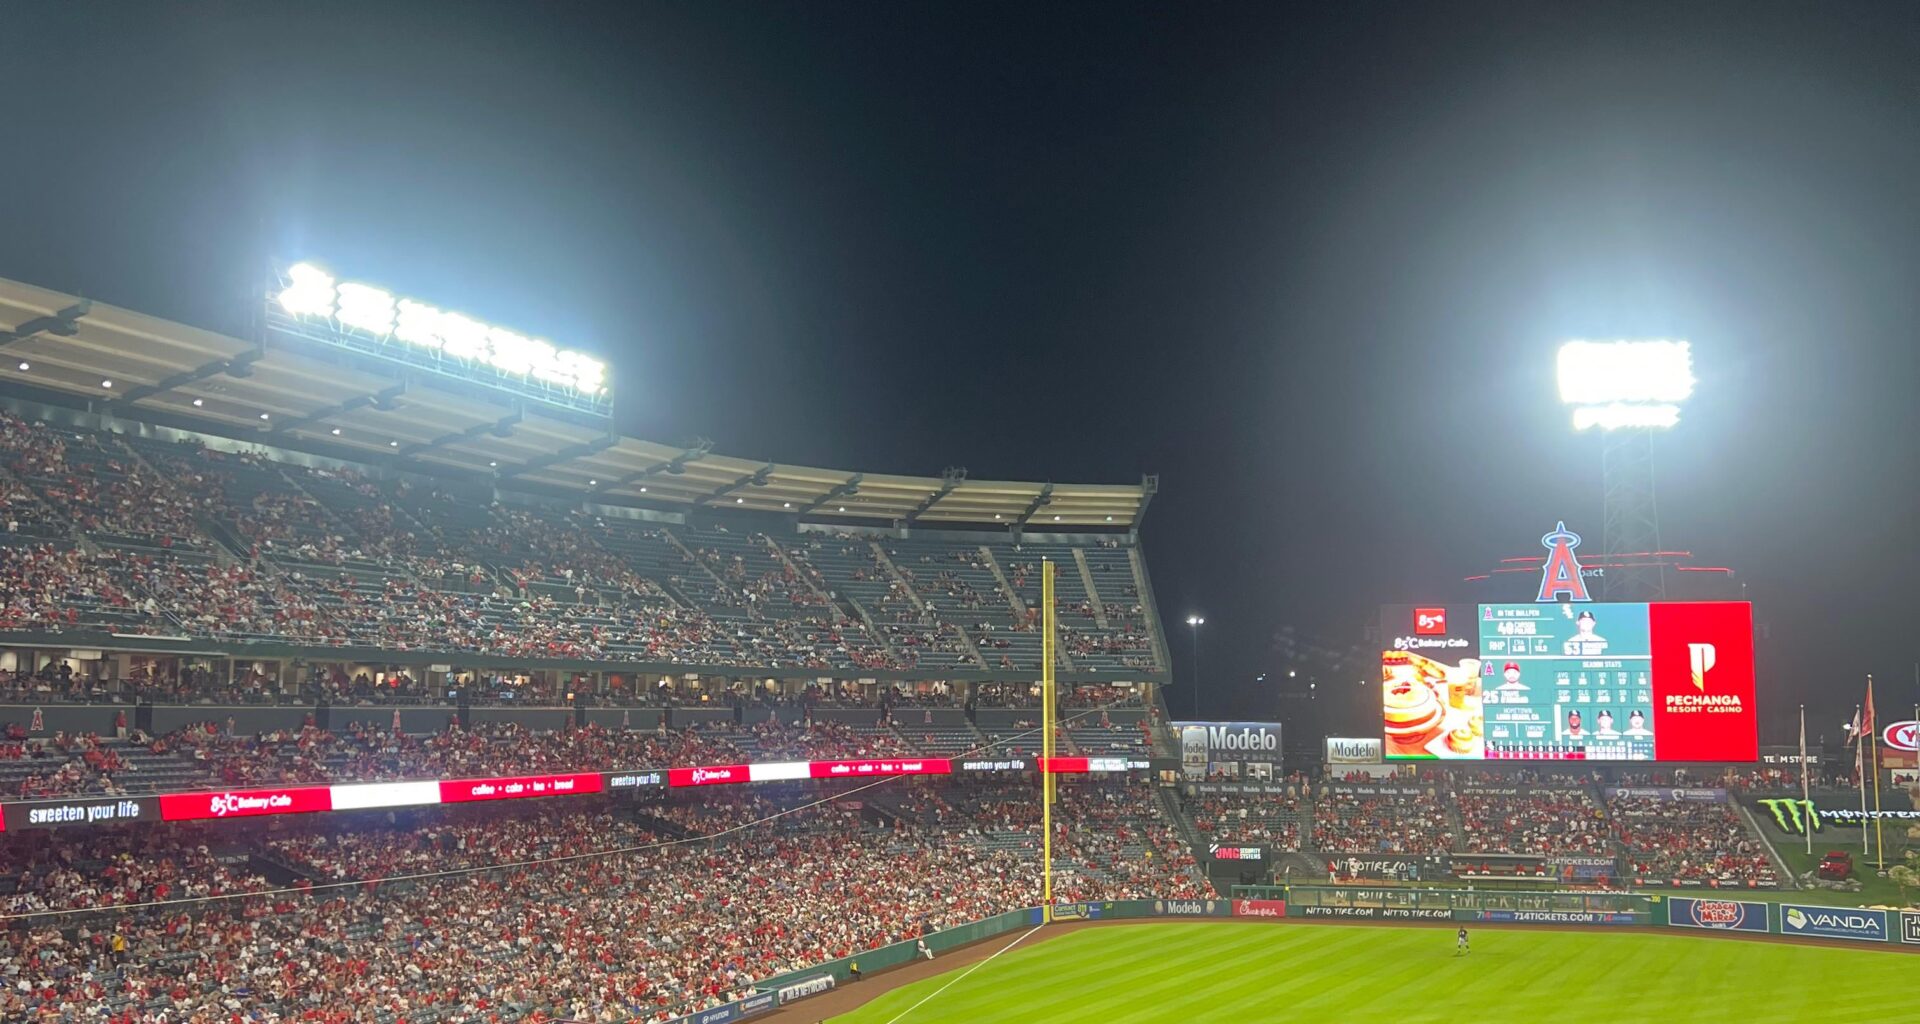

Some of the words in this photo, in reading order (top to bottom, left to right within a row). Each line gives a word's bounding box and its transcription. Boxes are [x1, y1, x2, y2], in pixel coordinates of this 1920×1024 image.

[1418, 638, 1447, 648] Bakery
[1447, 638, 1469, 647] Cafe
[1482, 690, 1499, 704] 25
[1666, 695, 1741, 705] PECHANGA
[1210, 726, 1277, 750] Modelo
[1334, 742, 1375, 757] Modelo
[963, 762, 993, 770] sweeten
[994, 762, 1010, 771] your
[1011, 760, 1025, 769] life
[611, 775, 635, 787] sweeten
[636, 775, 650, 787] your
[650, 772, 660, 784] life
[472, 786, 495, 796] coffee
[506, 783, 523, 793] cake
[239, 796, 269, 810] Bakery
[269, 795, 292, 807] Cafe
[30, 805, 84, 824] sweeten
[87, 803, 115, 822] your
[118, 801, 139, 818] life
[1547, 858, 1614, 866] 714TICKETS.COM
[1168, 901, 1201, 914] Modelo
[1334, 908, 1374, 916] TIRE.COM
[1698, 901, 1736, 912] Jersey
[1383, 909, 1409, 917] NITTO
[1411, 910, 1452, 918] TIRE.COM
[1514, 912, 1593, 921] 714TICKETS.COM
[1808, 914, 1880, 930] VANDA
[709, 1010, 729, 1023] HYUNDAI
